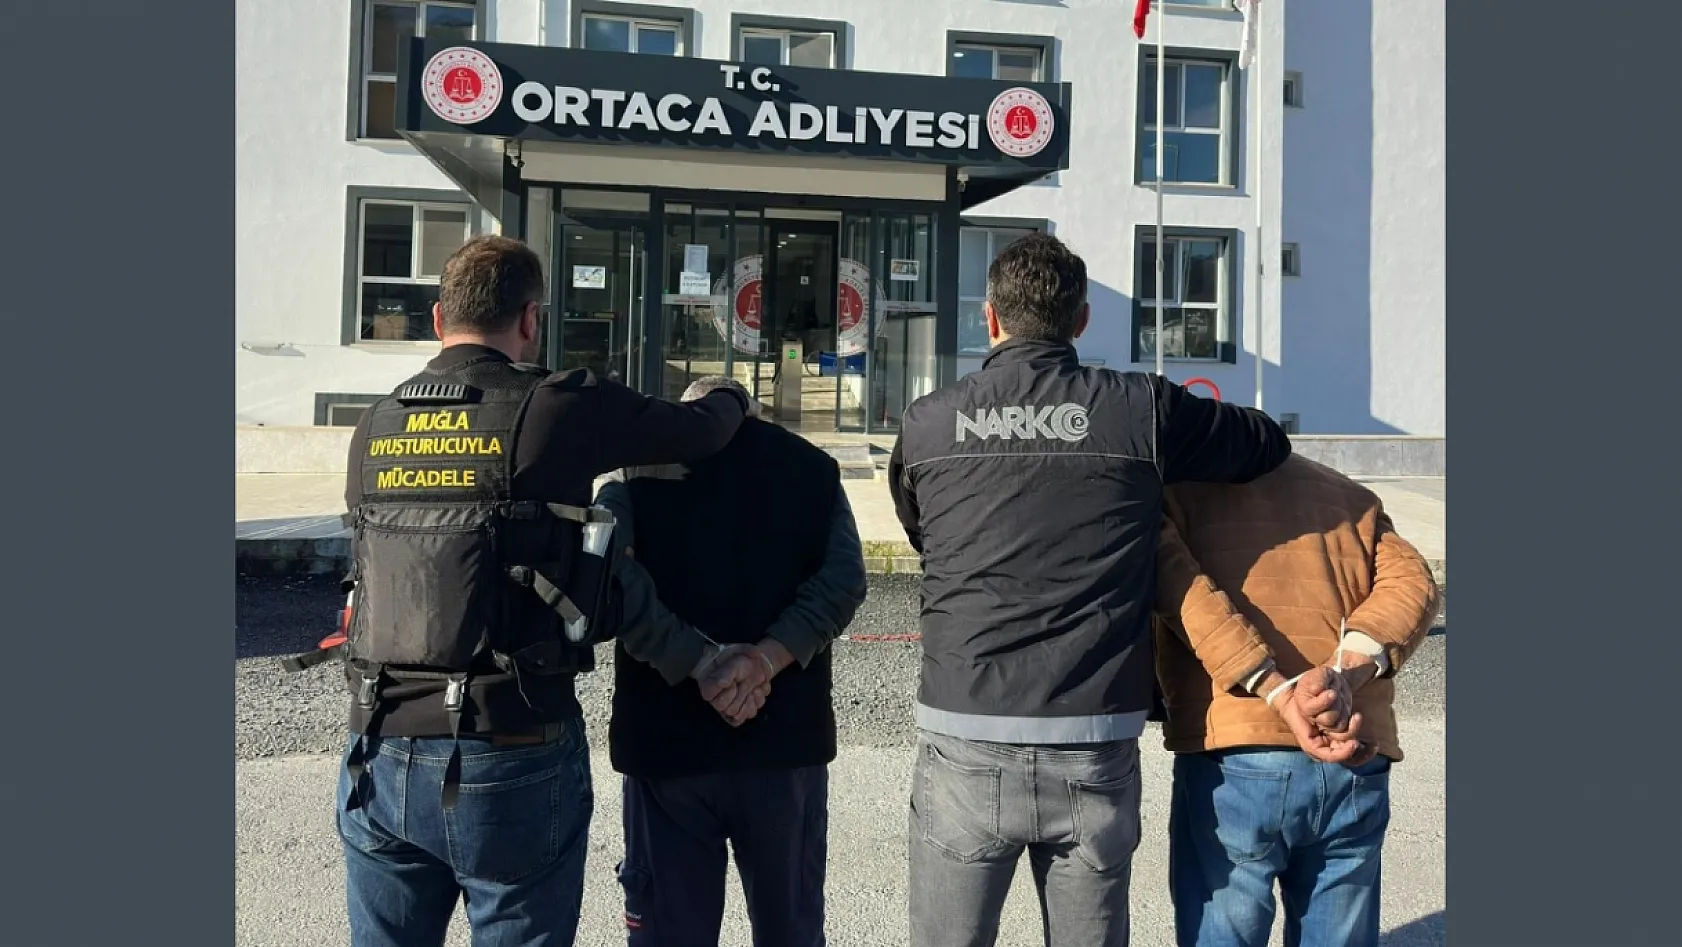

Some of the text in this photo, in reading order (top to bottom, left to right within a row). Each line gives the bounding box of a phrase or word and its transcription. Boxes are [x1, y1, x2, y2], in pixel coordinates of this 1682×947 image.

[512, 81, 732, 135] ORTACA
[748, 100, 980, 150] ADLİYESİ
[405, 410, 469, 432] MUĞLA
[369, 437, 502, 457] UYUŞTURUCUYLA
[377, 467, 475, 489] MÜCADELE
